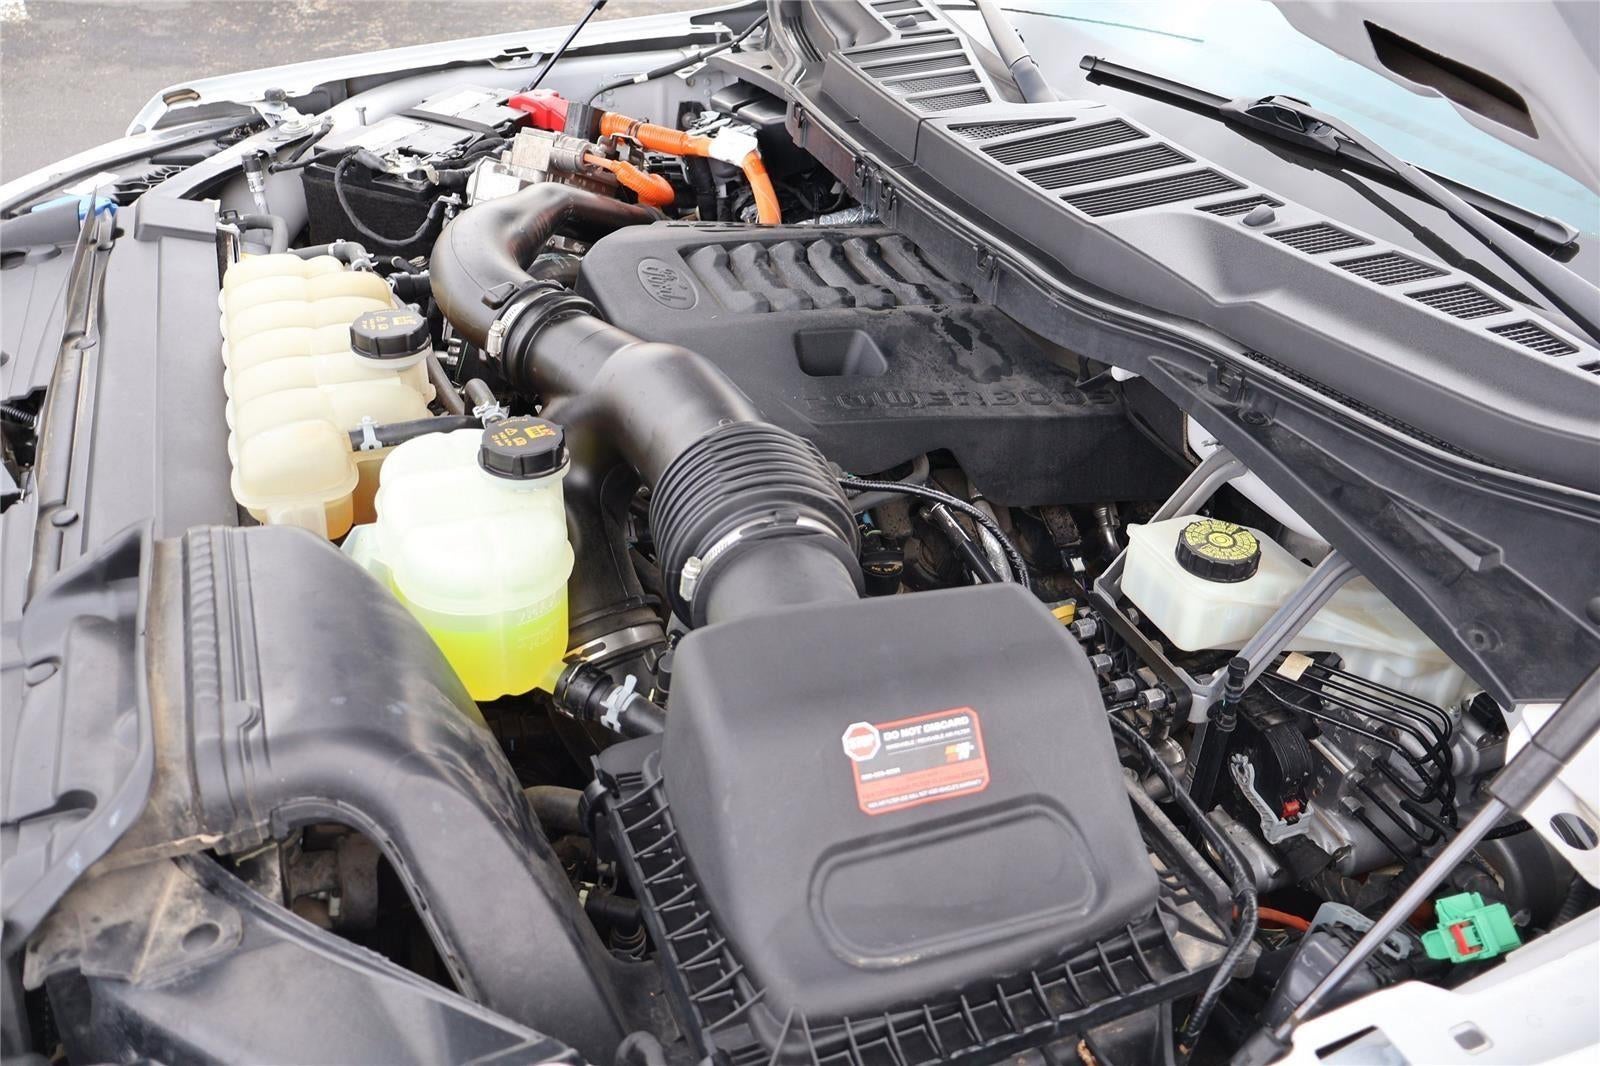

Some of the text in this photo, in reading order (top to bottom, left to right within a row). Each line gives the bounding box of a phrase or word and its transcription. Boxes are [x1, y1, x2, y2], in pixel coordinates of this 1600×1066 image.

[883, 731, 900, 741] DO
[900, 725, 923, 738] NOT
[923, 715, 970, 733] DISCARD
